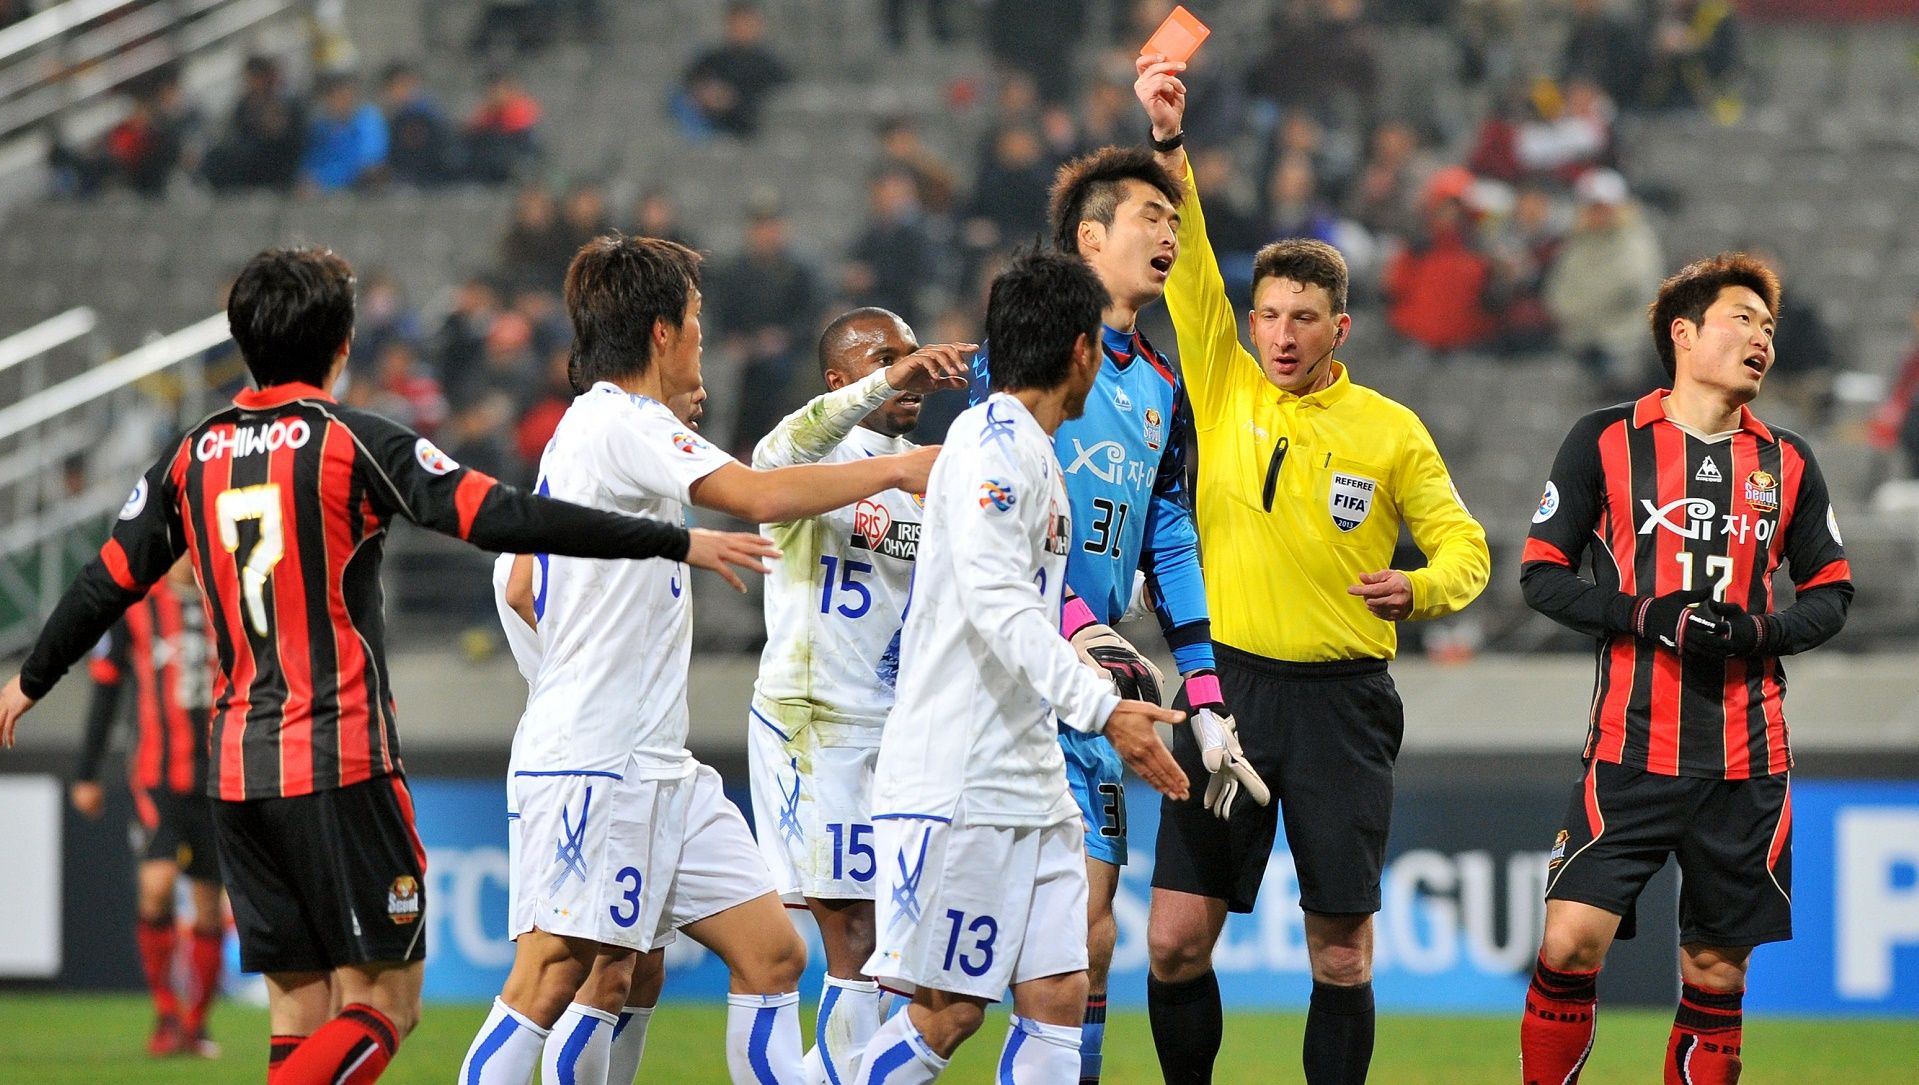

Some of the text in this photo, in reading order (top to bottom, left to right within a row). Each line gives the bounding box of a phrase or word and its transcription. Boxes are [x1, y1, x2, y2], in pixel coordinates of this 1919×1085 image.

[197, 419, 310, 462] CHIWOO
[1334, 494, 1365, 512] FIFA
[1335, 476, 1373, 491] REFEREE
[1745, 482, 1777, 504] Seoul
[854, 512, 880, 538] IRIS
[1083, 496, 1128, 559] 31
[1338, 520, 1354, 528] 2013
[1720, 514, 1776, 549] 자이
[216, 484, 283, 637] 7
[1675, 552, 1733, 605] 17
[820, 555, 873, 619] 15
[826, 823, 876, 882] 15
[609, 866, 642, 928] 3
[942, 909, 998, 977] 13
